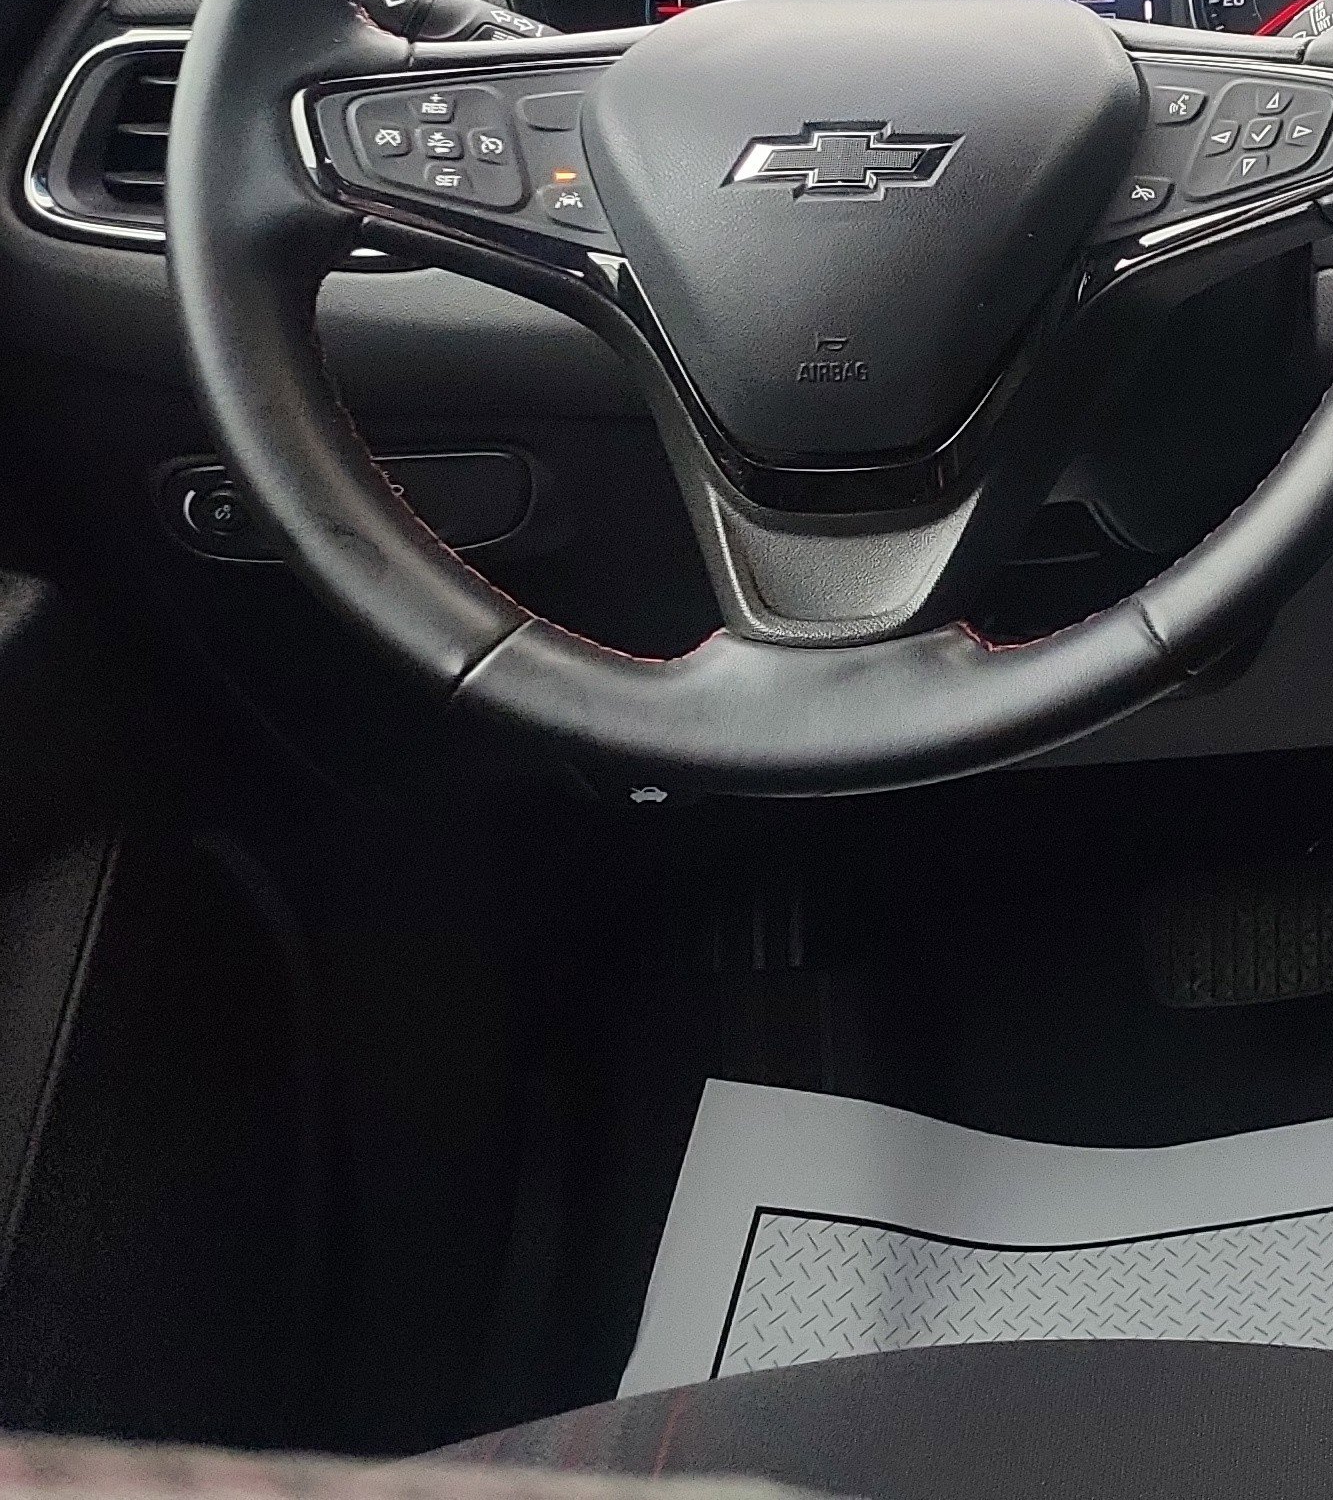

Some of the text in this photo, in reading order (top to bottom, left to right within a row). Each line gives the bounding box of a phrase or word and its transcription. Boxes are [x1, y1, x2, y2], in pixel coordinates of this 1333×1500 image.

[1316, 15, 1331, 32] INT
[421, 102, 448, 114] RES
[434, 174, 462, 187] SET
[796, 361, 867, 382] AIRBAG
